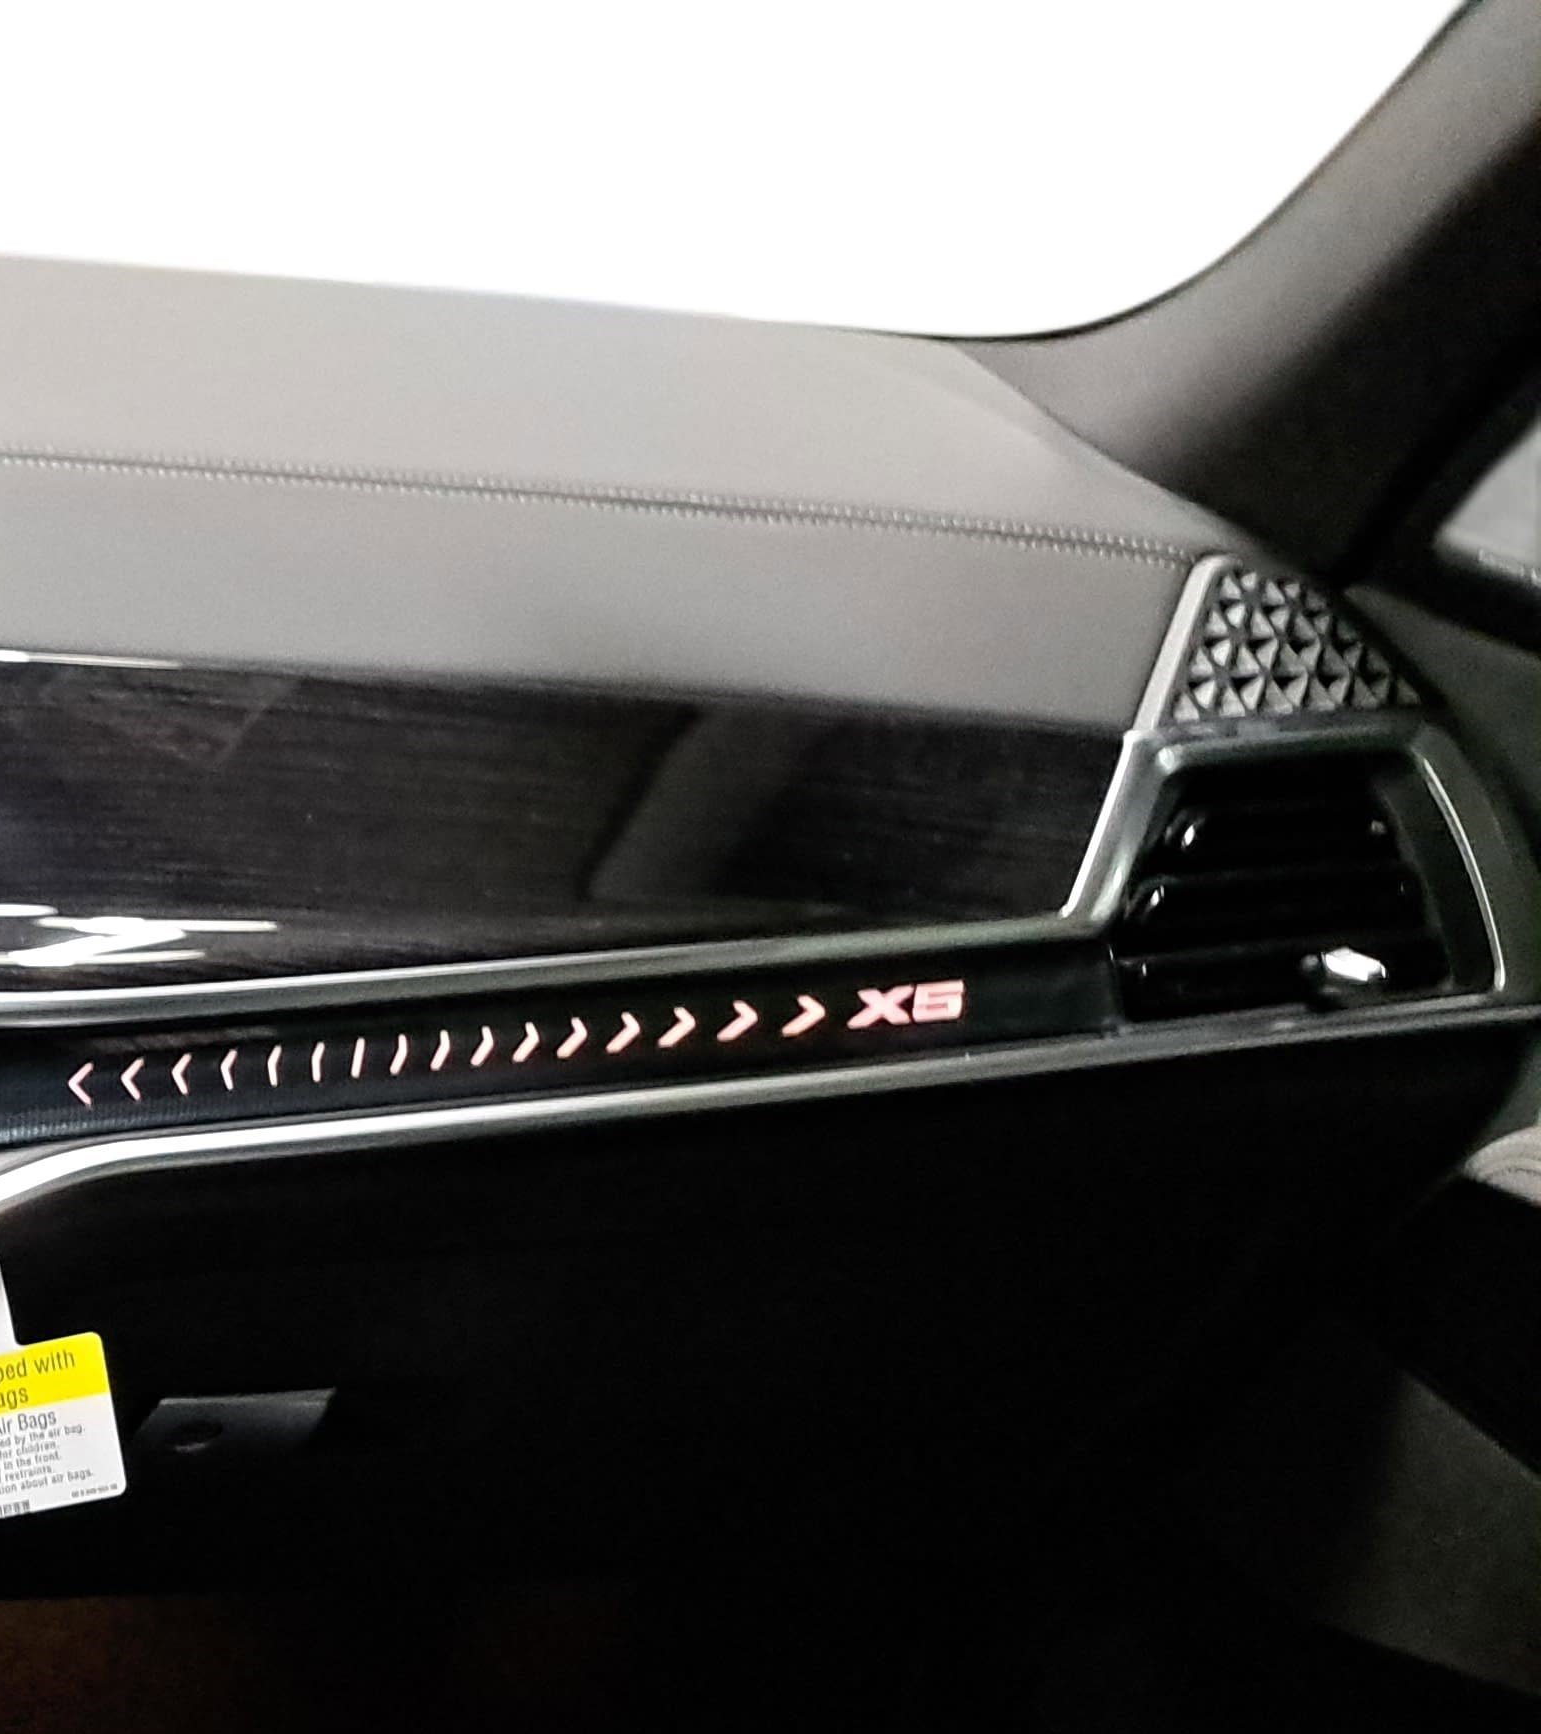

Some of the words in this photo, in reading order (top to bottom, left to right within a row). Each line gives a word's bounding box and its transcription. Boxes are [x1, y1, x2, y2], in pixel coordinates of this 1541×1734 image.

[847, 980, 965, 1029] X5
[34, 1349, 75, 1375] with
[17, 1411, 57, 1430] Bags
